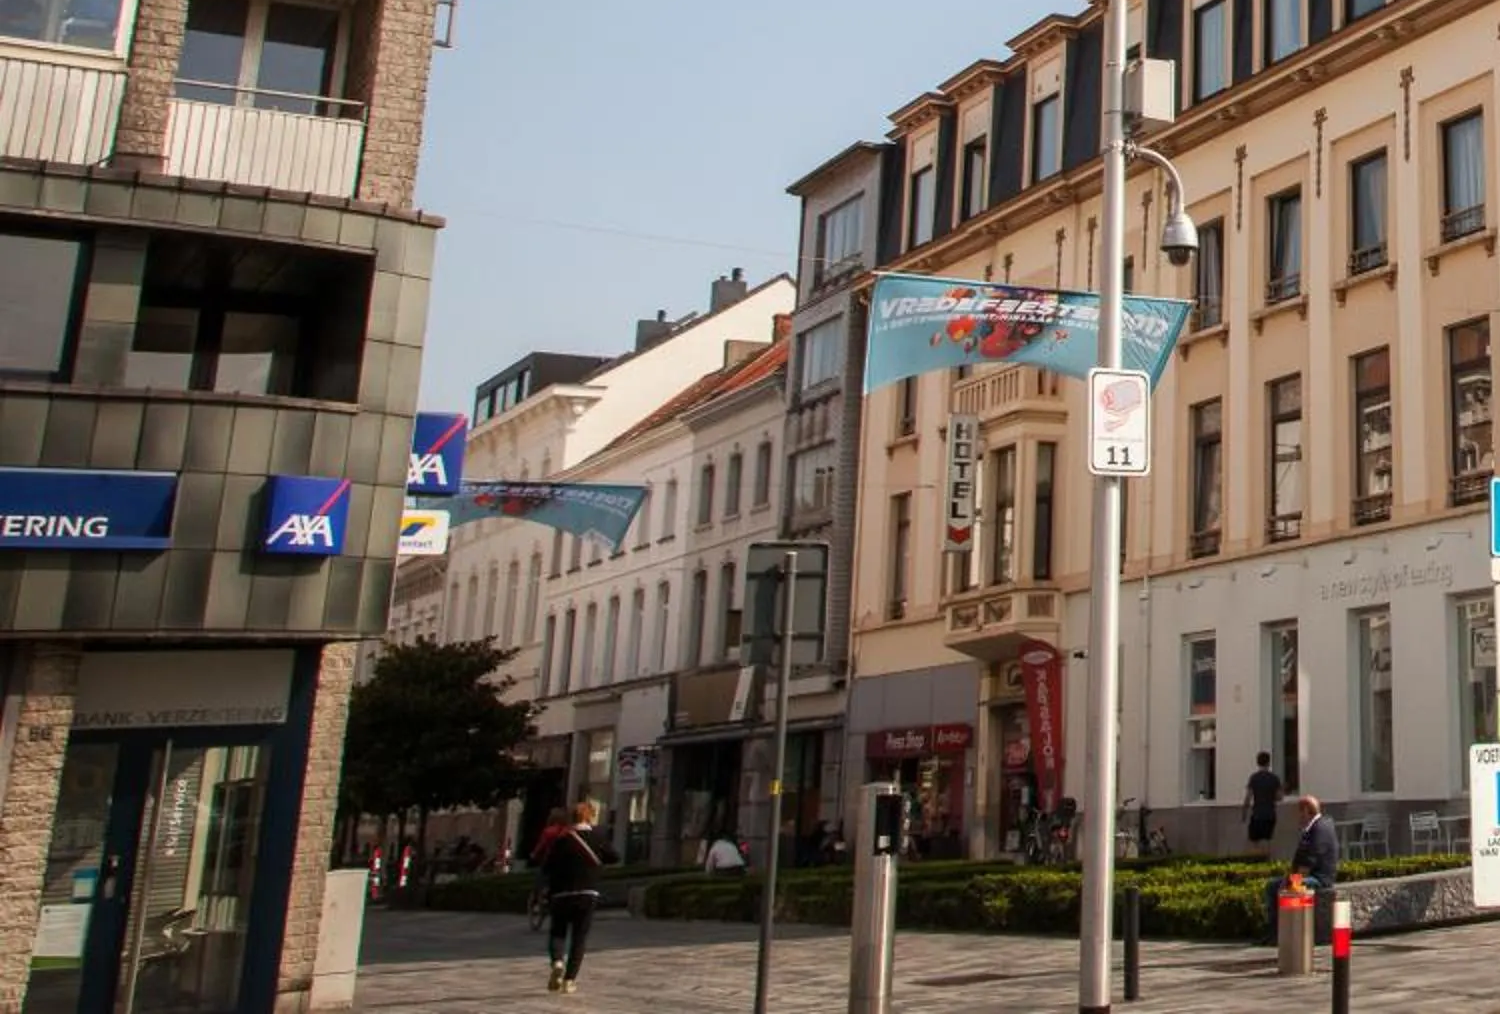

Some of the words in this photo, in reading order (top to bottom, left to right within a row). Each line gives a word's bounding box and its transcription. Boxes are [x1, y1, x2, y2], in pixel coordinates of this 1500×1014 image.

[881, 297, 1100, 321] VREDEFEESTE
[407, 453, 447, 485] XA
[1107, 446, 1131, 465] 11
[951, 423, 972, 518] HOTEL
[0, 515, 109, 538] ERING
[266, 514, 333, 546] AXA
